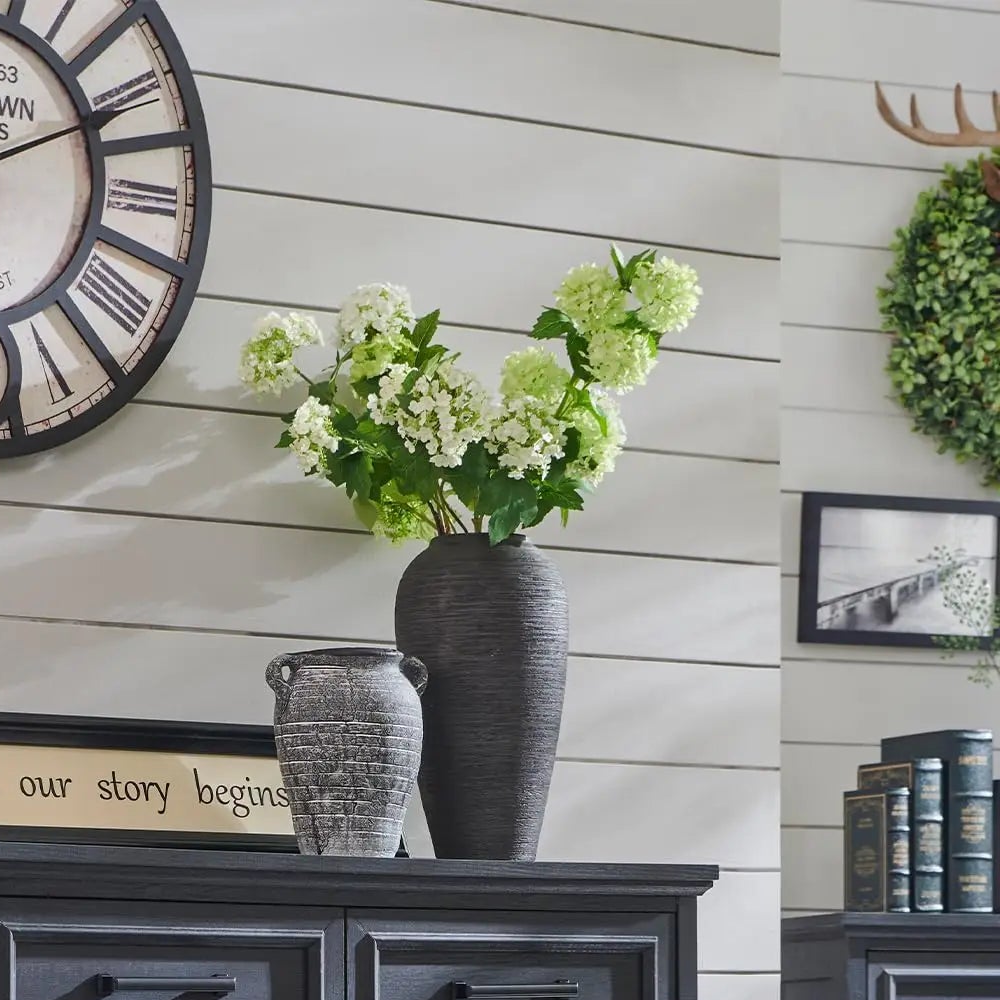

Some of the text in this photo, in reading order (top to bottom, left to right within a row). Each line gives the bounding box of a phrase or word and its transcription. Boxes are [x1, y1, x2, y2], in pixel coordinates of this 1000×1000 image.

[107, 177, 178, 221] III
[19, 775, 72, 798] our
[98, 771, 170, 814] story
[193, 768, 290, 818] begins
